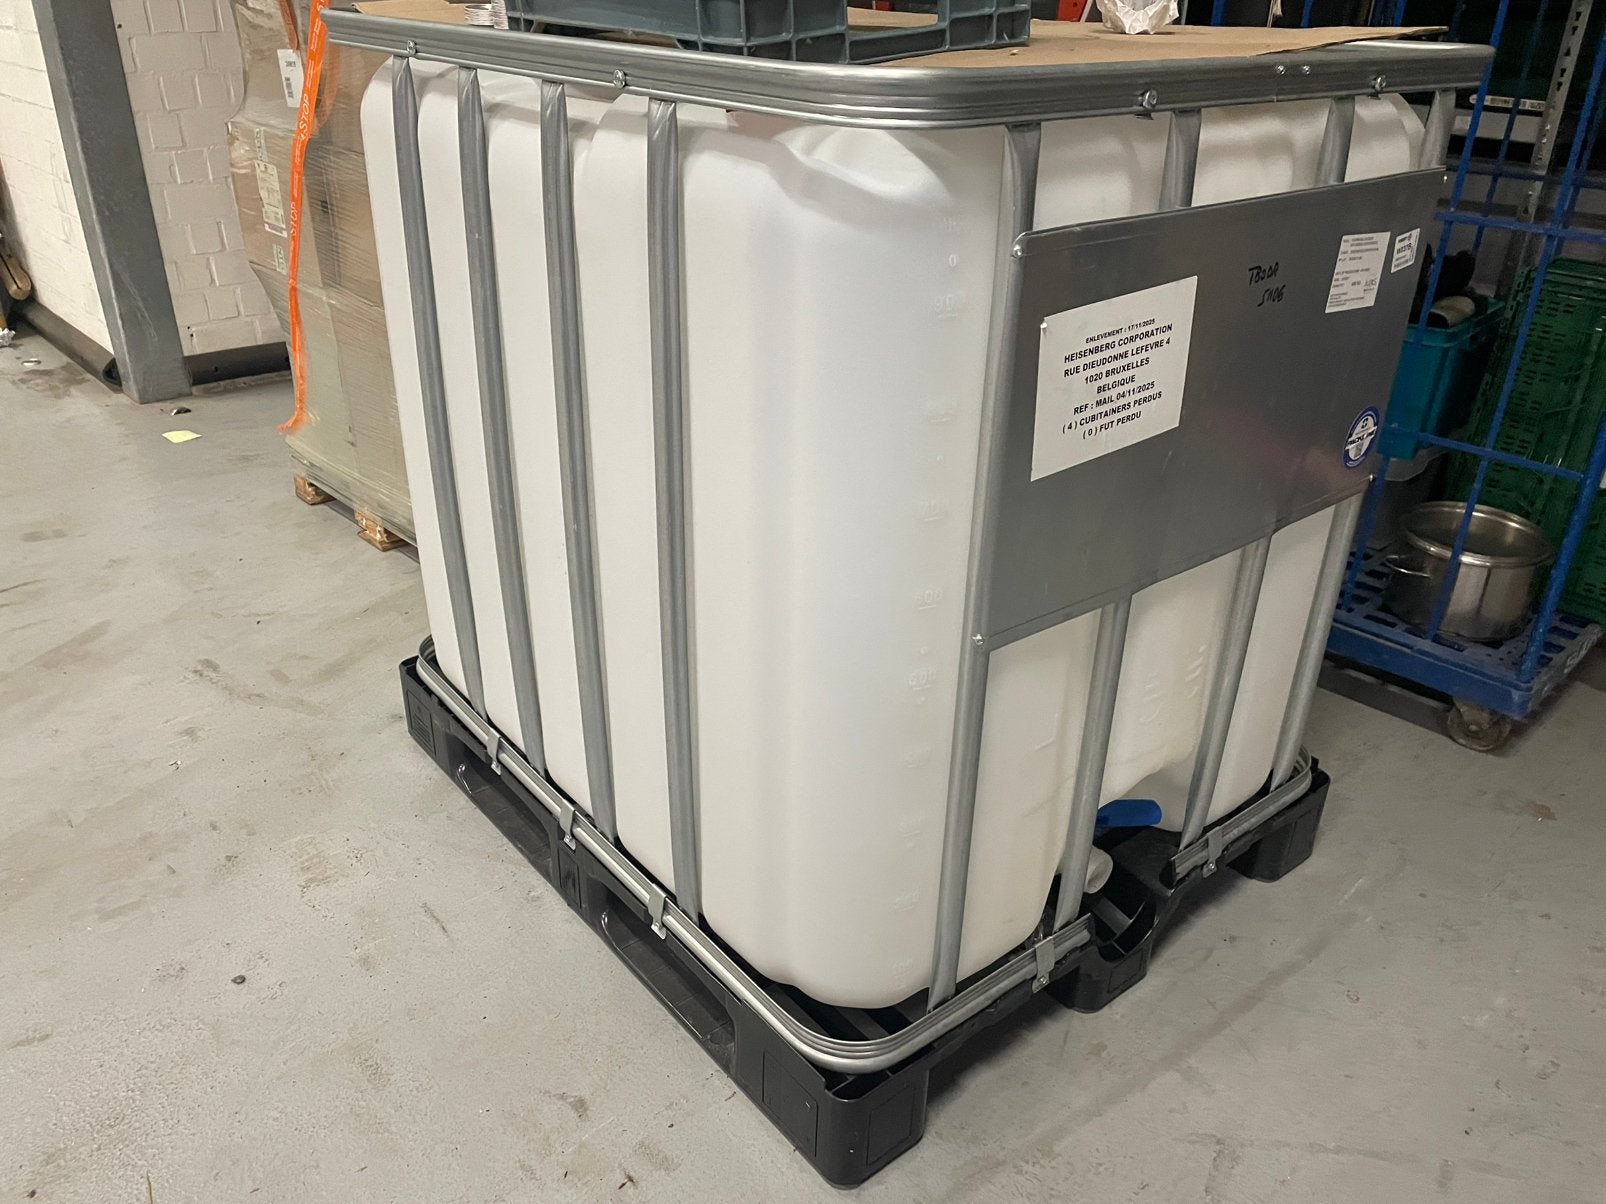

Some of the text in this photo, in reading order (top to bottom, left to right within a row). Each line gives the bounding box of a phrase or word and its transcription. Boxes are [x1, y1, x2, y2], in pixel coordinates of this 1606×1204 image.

[299, 94, 310, 132] STOP
[289, 201, 299, 237] STOP
[1064, 323, 1173, 364] HEISENBERG CORPORATION
[1085, 327, 1124, 344] ENLEVEMENT
[1128, 318, 1156, 332] 17/11/2025
[1063, 337, 1171, 378] RUE DIEUDONNE LEFEVRE 4
[1085, 356, 1150, 385] 1020 BRUXELLES
[1073, 403, 1089, 416] REF
[1095, 394, 1115, 408] MAIL
[1116, 380, 1155, 401] 04/11/2025
[1096, 374, 1136, 394] BELGIQUE
[1079, 401, 1132, 427] CUBITAINERS
[1132, 391, 1163, 408] PERDUS
[1099, 419, 1115, 433] FUT
[1116, 410, 1142, 426] PERDU
